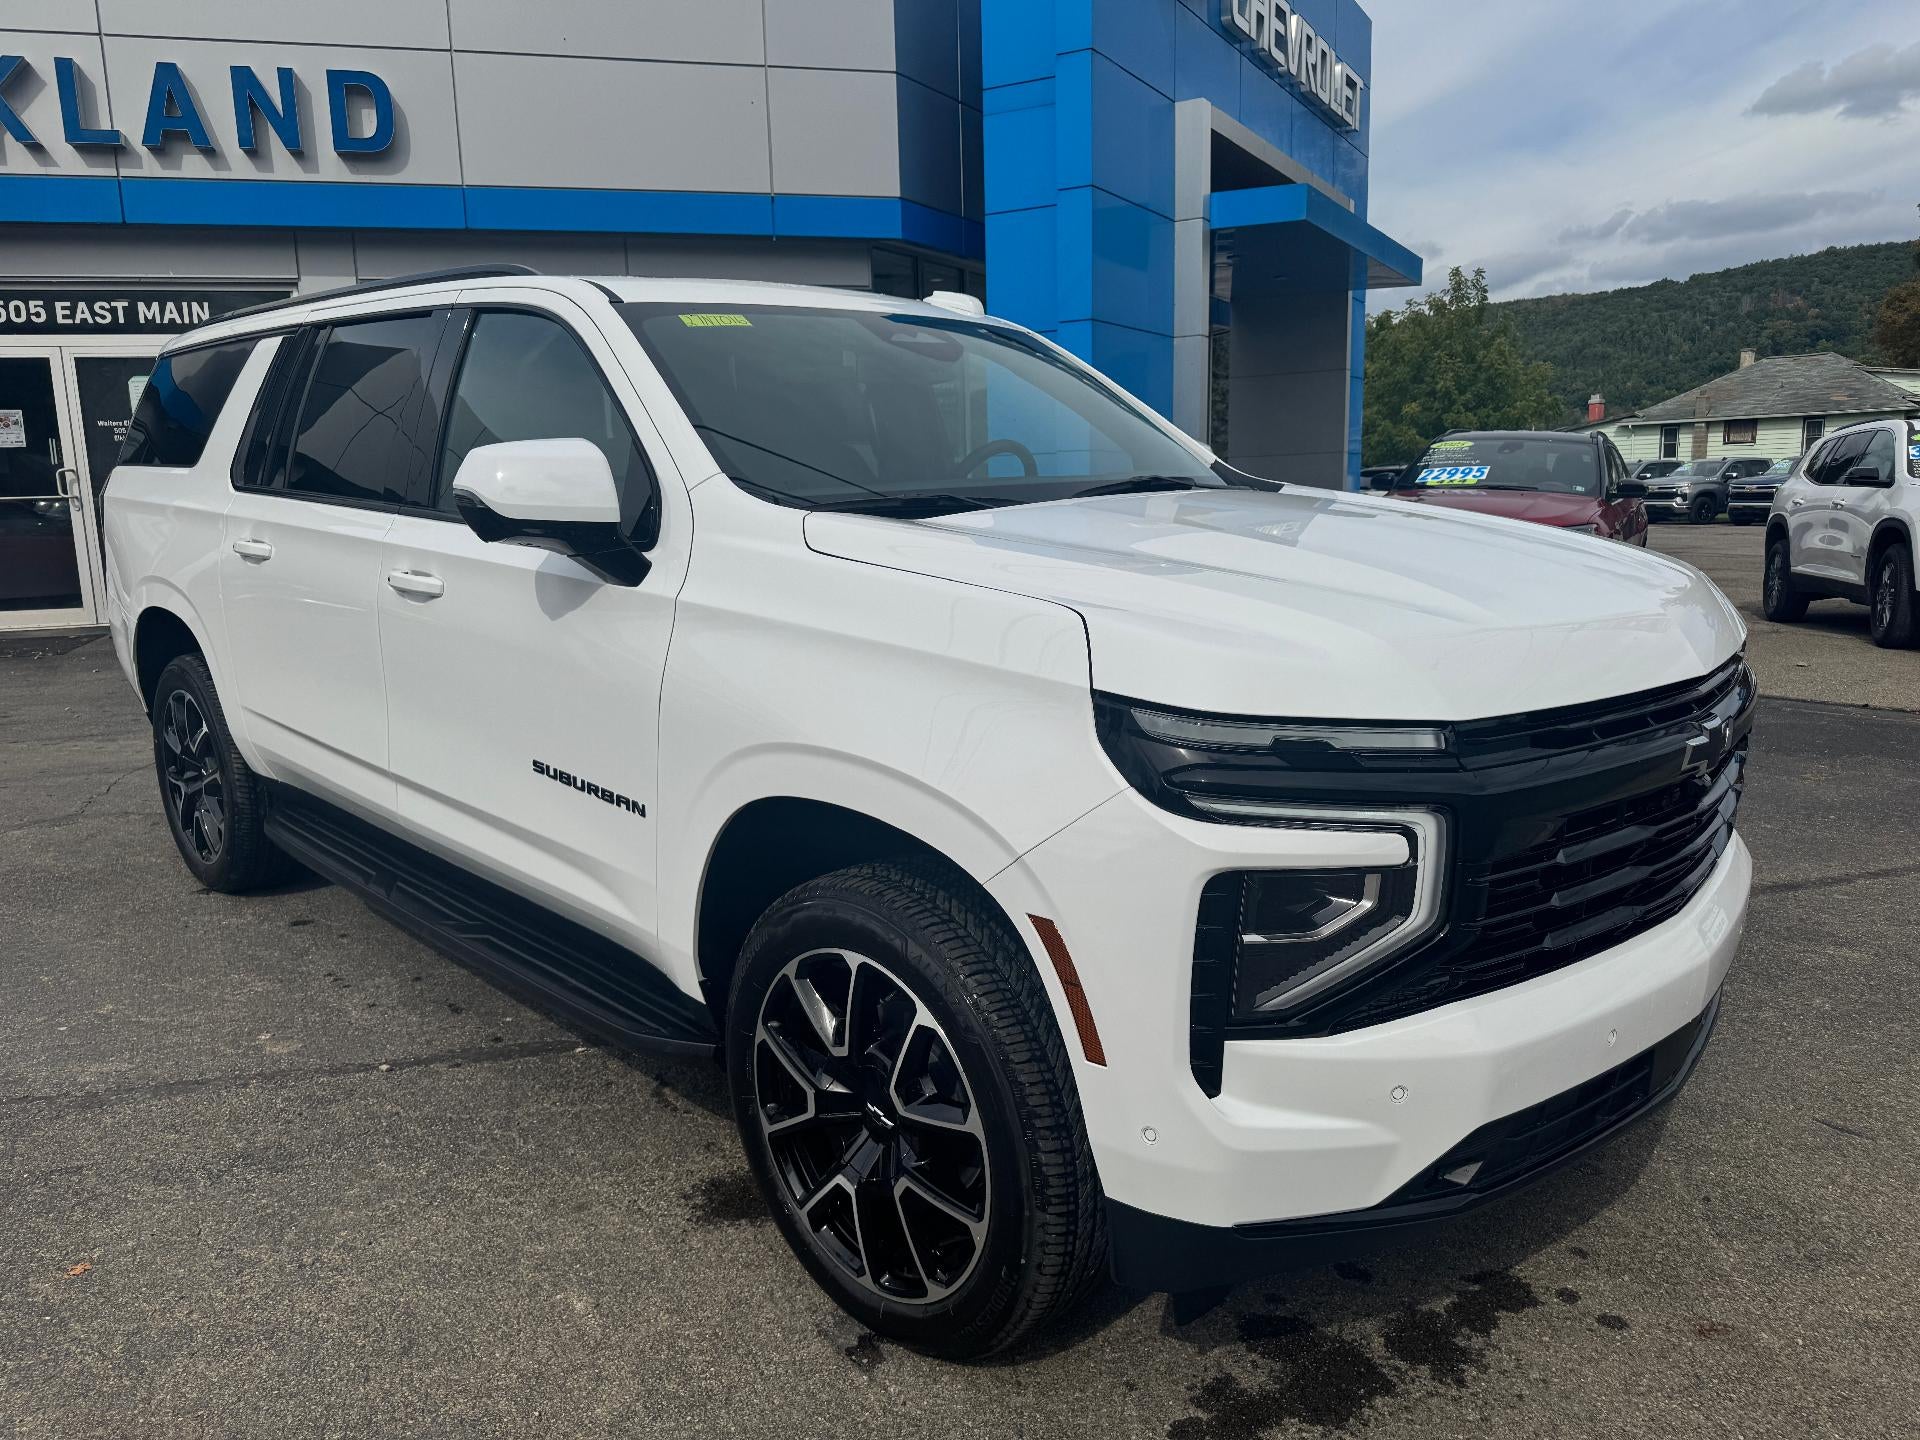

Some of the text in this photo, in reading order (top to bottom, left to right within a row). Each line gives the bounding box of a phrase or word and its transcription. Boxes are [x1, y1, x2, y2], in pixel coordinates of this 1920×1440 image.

[54, 301, 129, 324] EAST
[137, 301, 210, 324] MAIN
[1418, 466, 1487, 481] 22995
[532, 759, 646, 818] SUBURBAN
